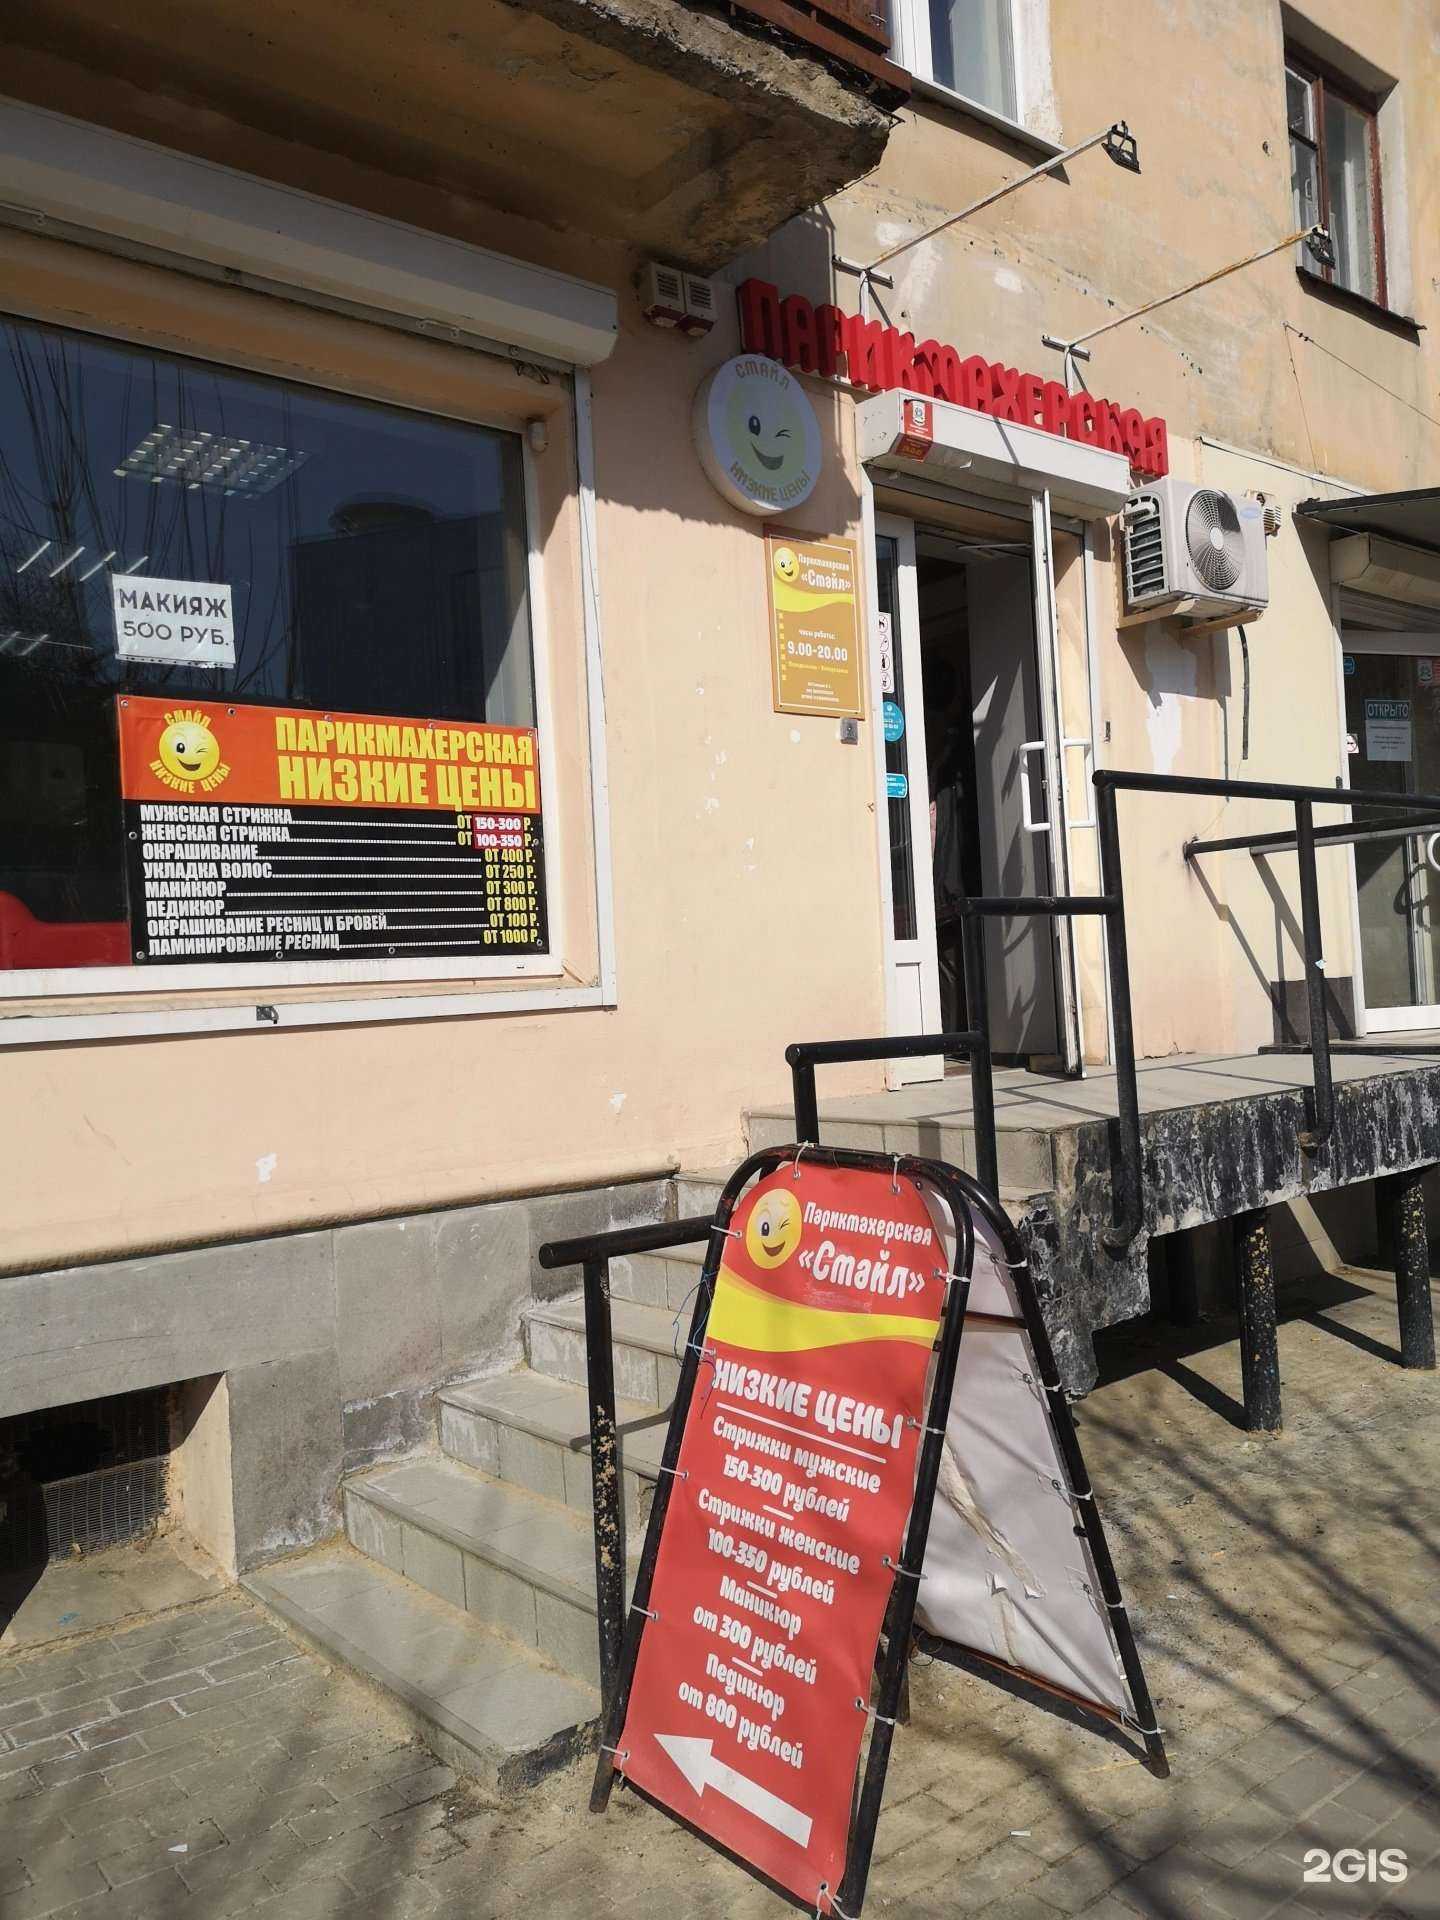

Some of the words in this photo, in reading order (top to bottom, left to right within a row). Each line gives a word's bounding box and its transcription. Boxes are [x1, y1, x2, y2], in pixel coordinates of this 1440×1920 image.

[780, 469, 811, 501] ЦЕНЫ
[119, 589, 228, 619] МАКИЯЖ
[122, 620, 172, 641] 500
[180, 626, 230, 647] РУБ.
[787, 640, 848, 661] 9.00-20.00
[163, 708, 212, 728] СМАЙЛ
[1367, 703, 1409, 717] ОТКРЫТО
[274, 716, 534, 766] ПАРИКМАХЕРСКАЯ
[149, 760, 195, 793] НИЗКИЕ
[200, 762, 231, 792] ЦЕНЫ
[278, 755, 429, 804] НИЗКИЕ
[437, 767, 537, 812] ЦЕНЫ
[140, 804, 219, 823] МУЖСКАЯ
[223, 808, 292, 824] СТРИЖКА
[457, 814, 472, 829] ОТ
[475, 816, 521, 831] 150-300
[141, 824, 217, 841] ЖЕНСКАЯ
[220, 826, 291, 842] СТРИЖКА
[457, 831, 472, 846] ОТ
[477, 833, 522, 847] 100-350
[142, 843, 258, 860] ОКРАШИВАНИЕ
[484, 848, 499, 863] ОТ
[501, 848, 523, 863] 400
[143, 862, 218, 880] УКЛАДКА
[221, 863, 273, 879] ВОЛОС
[485, 865, 500, 879] ОТ
[502, 864, 524, 879] 250
[145, 881, 227, 898] МАНИКЮР
[486, 881, 501, 895] ОТ
[503, 881, 525, 895] 300
[146, 900, 225, 919] ПЕДИКЮР
[487, 897, 502, 911] ОТ
[504, 897, 527, 911] 800
[147, 917, 264, 937] ОКРАШИВАНИЕ
[266, 916, 323, 933] РЕСНИЦ
[324, 916, 333, 931] И
[336, 913, 387, 931] БРОВЕЙ
[489, 913, 504, 927] ОТ
[506, 913, 528, 927] 100
[149, 936, 283, 956] ЛАМИНИРОВАНИЕ
[285, 934, 340, 951] РЕСНИЦ
[483, 929, 498, 944] ОТ
[500, 929, 529, 944] 1000
[712, 1359, 812, 1418] НИЗКИЕ
[814, 1390, 903, 1449] ЦЕНЫ
[713, 1416, 792, 1461] Стрижки
[793, 1447, 881, 1494] мужские
[723, 1454, 783, 1495] 150-300
[783, 1482, 850, 1522] рублей
[698, 1488, 776, 1539] Стрижки
[778, 1525, 860, 1575] женские
[708, 1528, 768, 1573] 100-350
[767, 1560, 835, 1605] рублей
[720, 1576, 802, 1640] Маникюр
[693, 1606, 718, 1632] от
[719, 1614, 752, 1649] 300
[751, 1636, 817, 1684] рублей
[706, 1653, 785, 1721] Педикюр
[678, 1682, 703, 1709] от
[705, 1694, 737, 1728] 800
[737, 1716, 803, 1769] рублей
